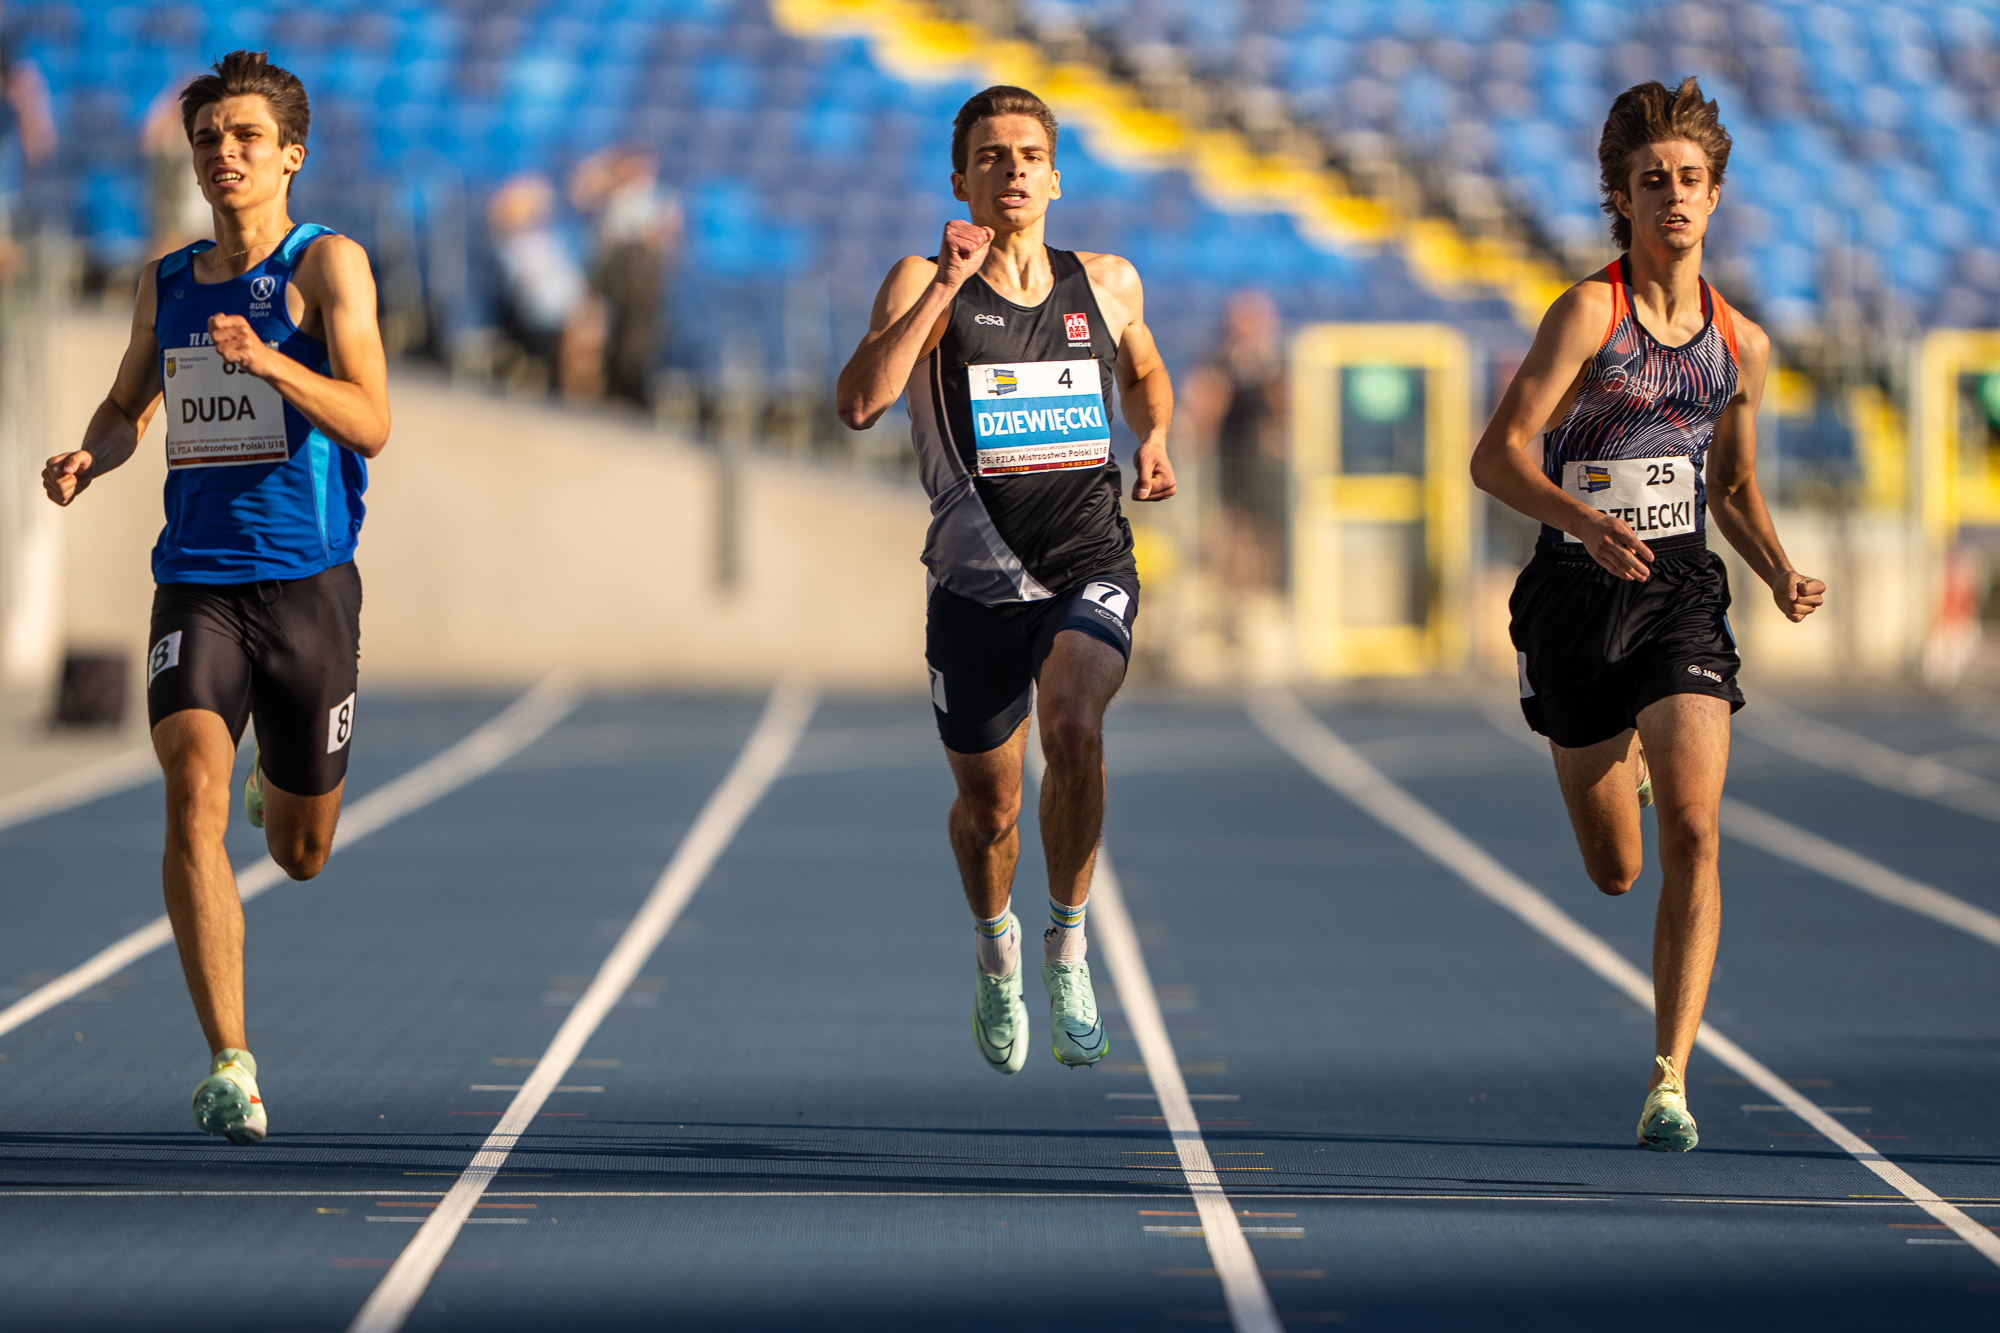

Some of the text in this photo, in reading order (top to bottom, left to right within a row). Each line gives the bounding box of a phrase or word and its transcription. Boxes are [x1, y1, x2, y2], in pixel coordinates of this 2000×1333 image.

[974, 313, 1006, 327] esa
[1057, 367, 1073, 389] 4
[181, 395, 257, 424] DUDA
[977, 405, 1103, 437] DZIEWIĘCKI
[178, 446, 192, 455] PZLA
[193, 443, 239, 453] Mistrzostwa
[240, 441, 266, 451] Polski
[267, 440, 285, 449] U18
[995, 455, 1016, 464] PZLA
[1018, 451, 1067, 462] Mistrzostwa
[1068, 448, 1092, 458] Polski
[1094, 446, 1107, 456] U18
[1646, 462, 1676, 486] 25
[1096, 583, 1122, 604] 7
[152, 639, 170, 675] 8
[1702, 669, 1722, 683] JAKO
[337, 703, 350, 744] 8
